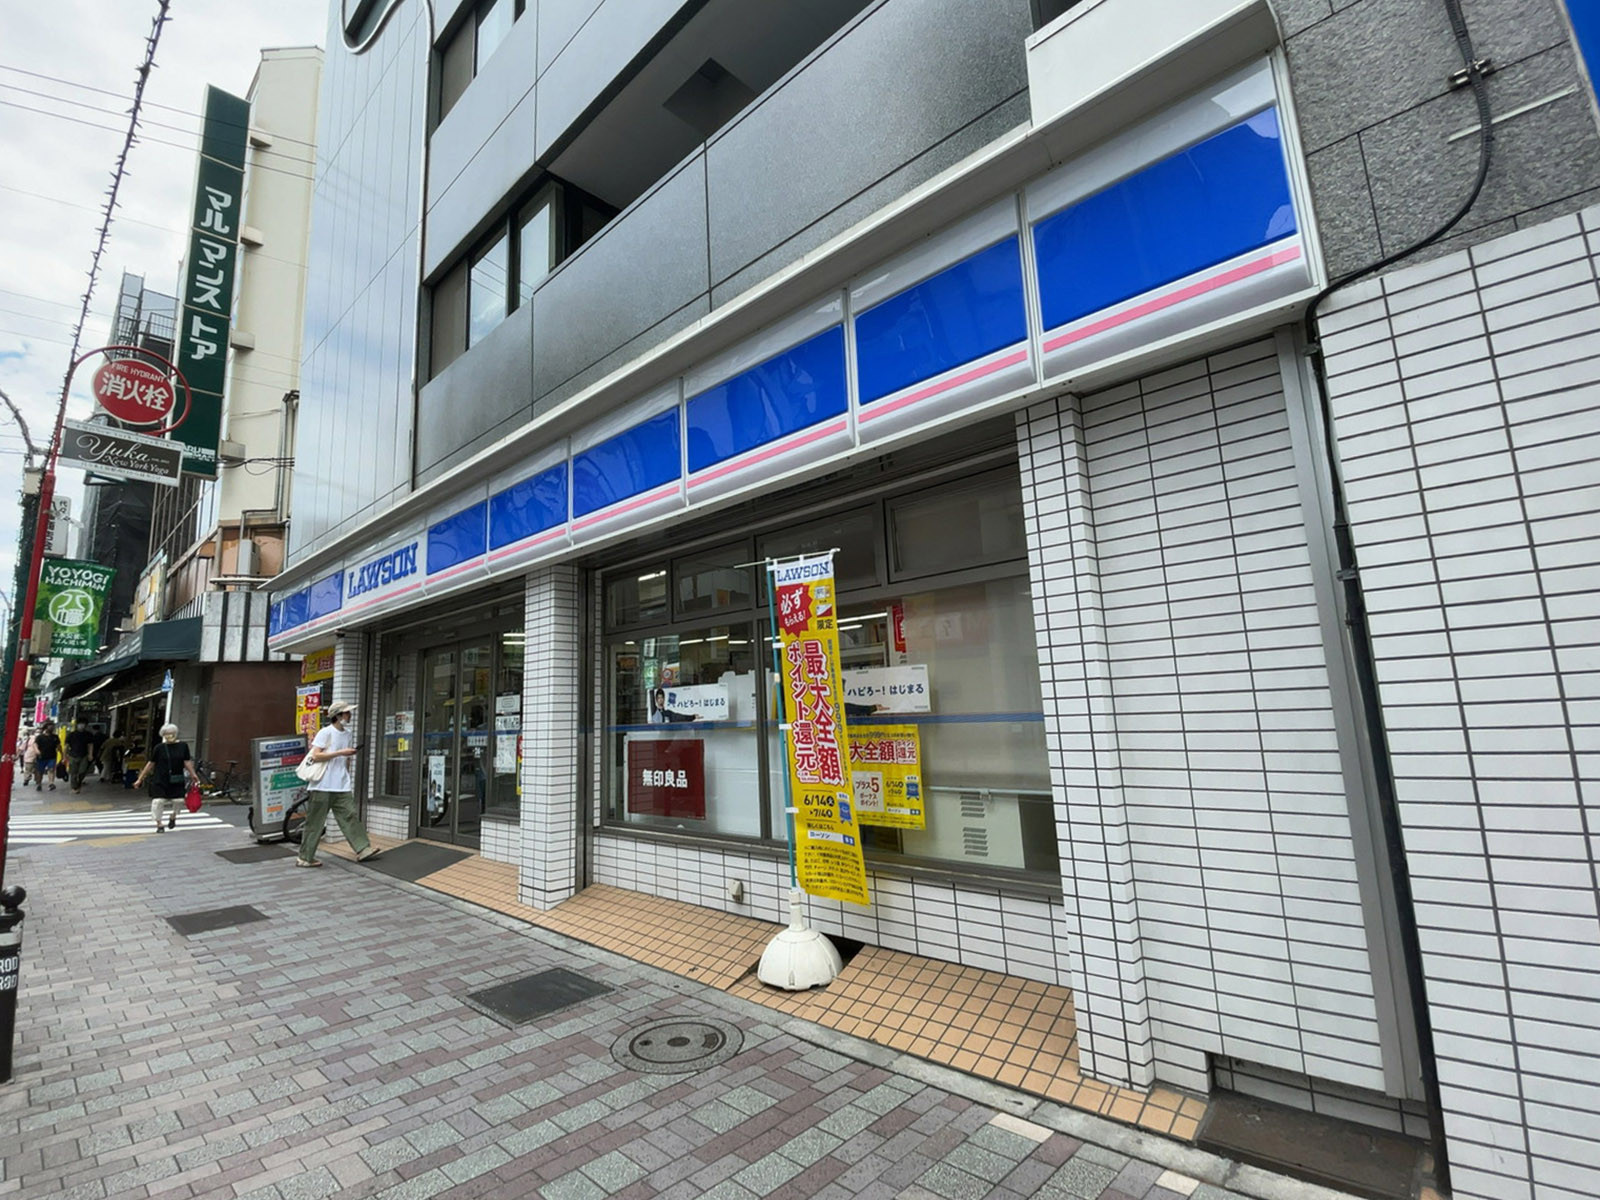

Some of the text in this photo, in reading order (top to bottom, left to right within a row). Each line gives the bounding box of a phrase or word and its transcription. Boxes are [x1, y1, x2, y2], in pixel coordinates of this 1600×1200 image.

[189, 186, 233, 361] マルマンストア
[111, 363, 165, 383] FIRE HYDRANT
[99, 371, 170, 412] 消火栓
[76, 434, 151, 462] Yuka
[102, 454, 129, 467] New
[129, 456, 150, 472] York
[150, 460, 170, 475] Yoga
[48, 565, 110, 585] YOYOGI
[347, 542, 418, 599] LAWSON
[777, 561, 830, 582] LAWSON
[45, 576, 105, 592] HACHIMAN
[781, 587, 804, 616] 必ず
[889, 683, 924, 695] はじまる
[703, 697, 725, 707] はじまる
[788, 642, 816, 770] ポイント還元
[803, 641, 843, 783] 最大全額
[849, 740, 895, 761] 大全額
[642, 768, 688, 789] 無印良品
